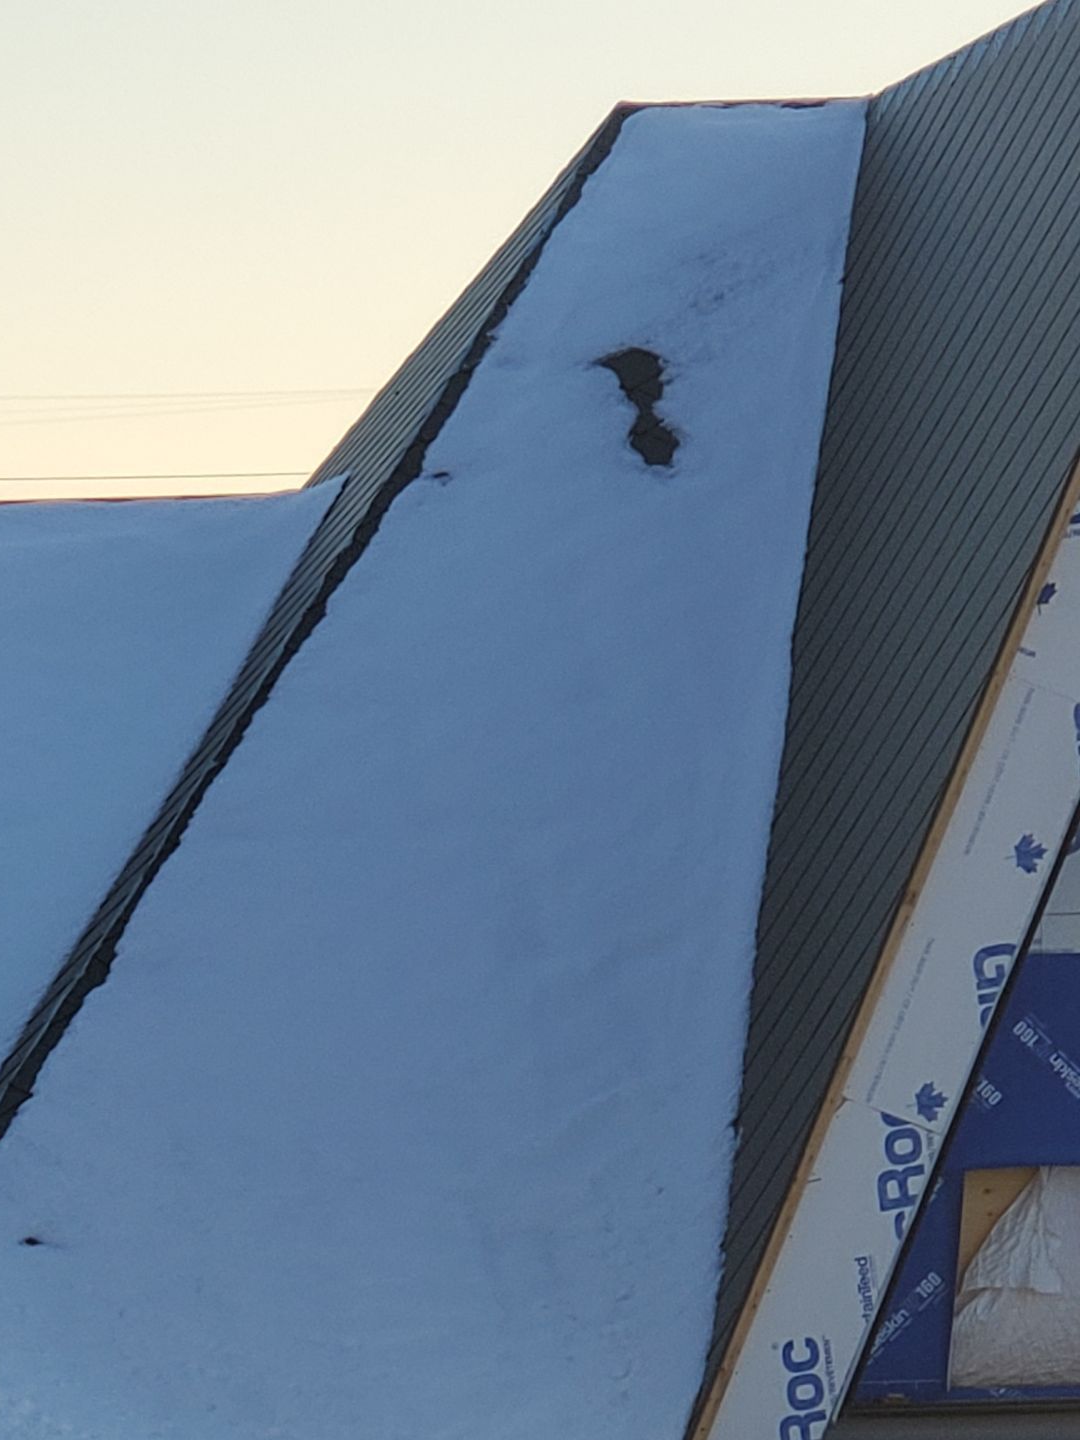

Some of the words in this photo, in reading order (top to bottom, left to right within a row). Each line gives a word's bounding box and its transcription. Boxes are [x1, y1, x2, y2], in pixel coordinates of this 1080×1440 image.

[1013, 1020, 1039, 1048] 160
[976, 1080, 1002, 1106] 160
[915, 1271, 942, 1298] 160
